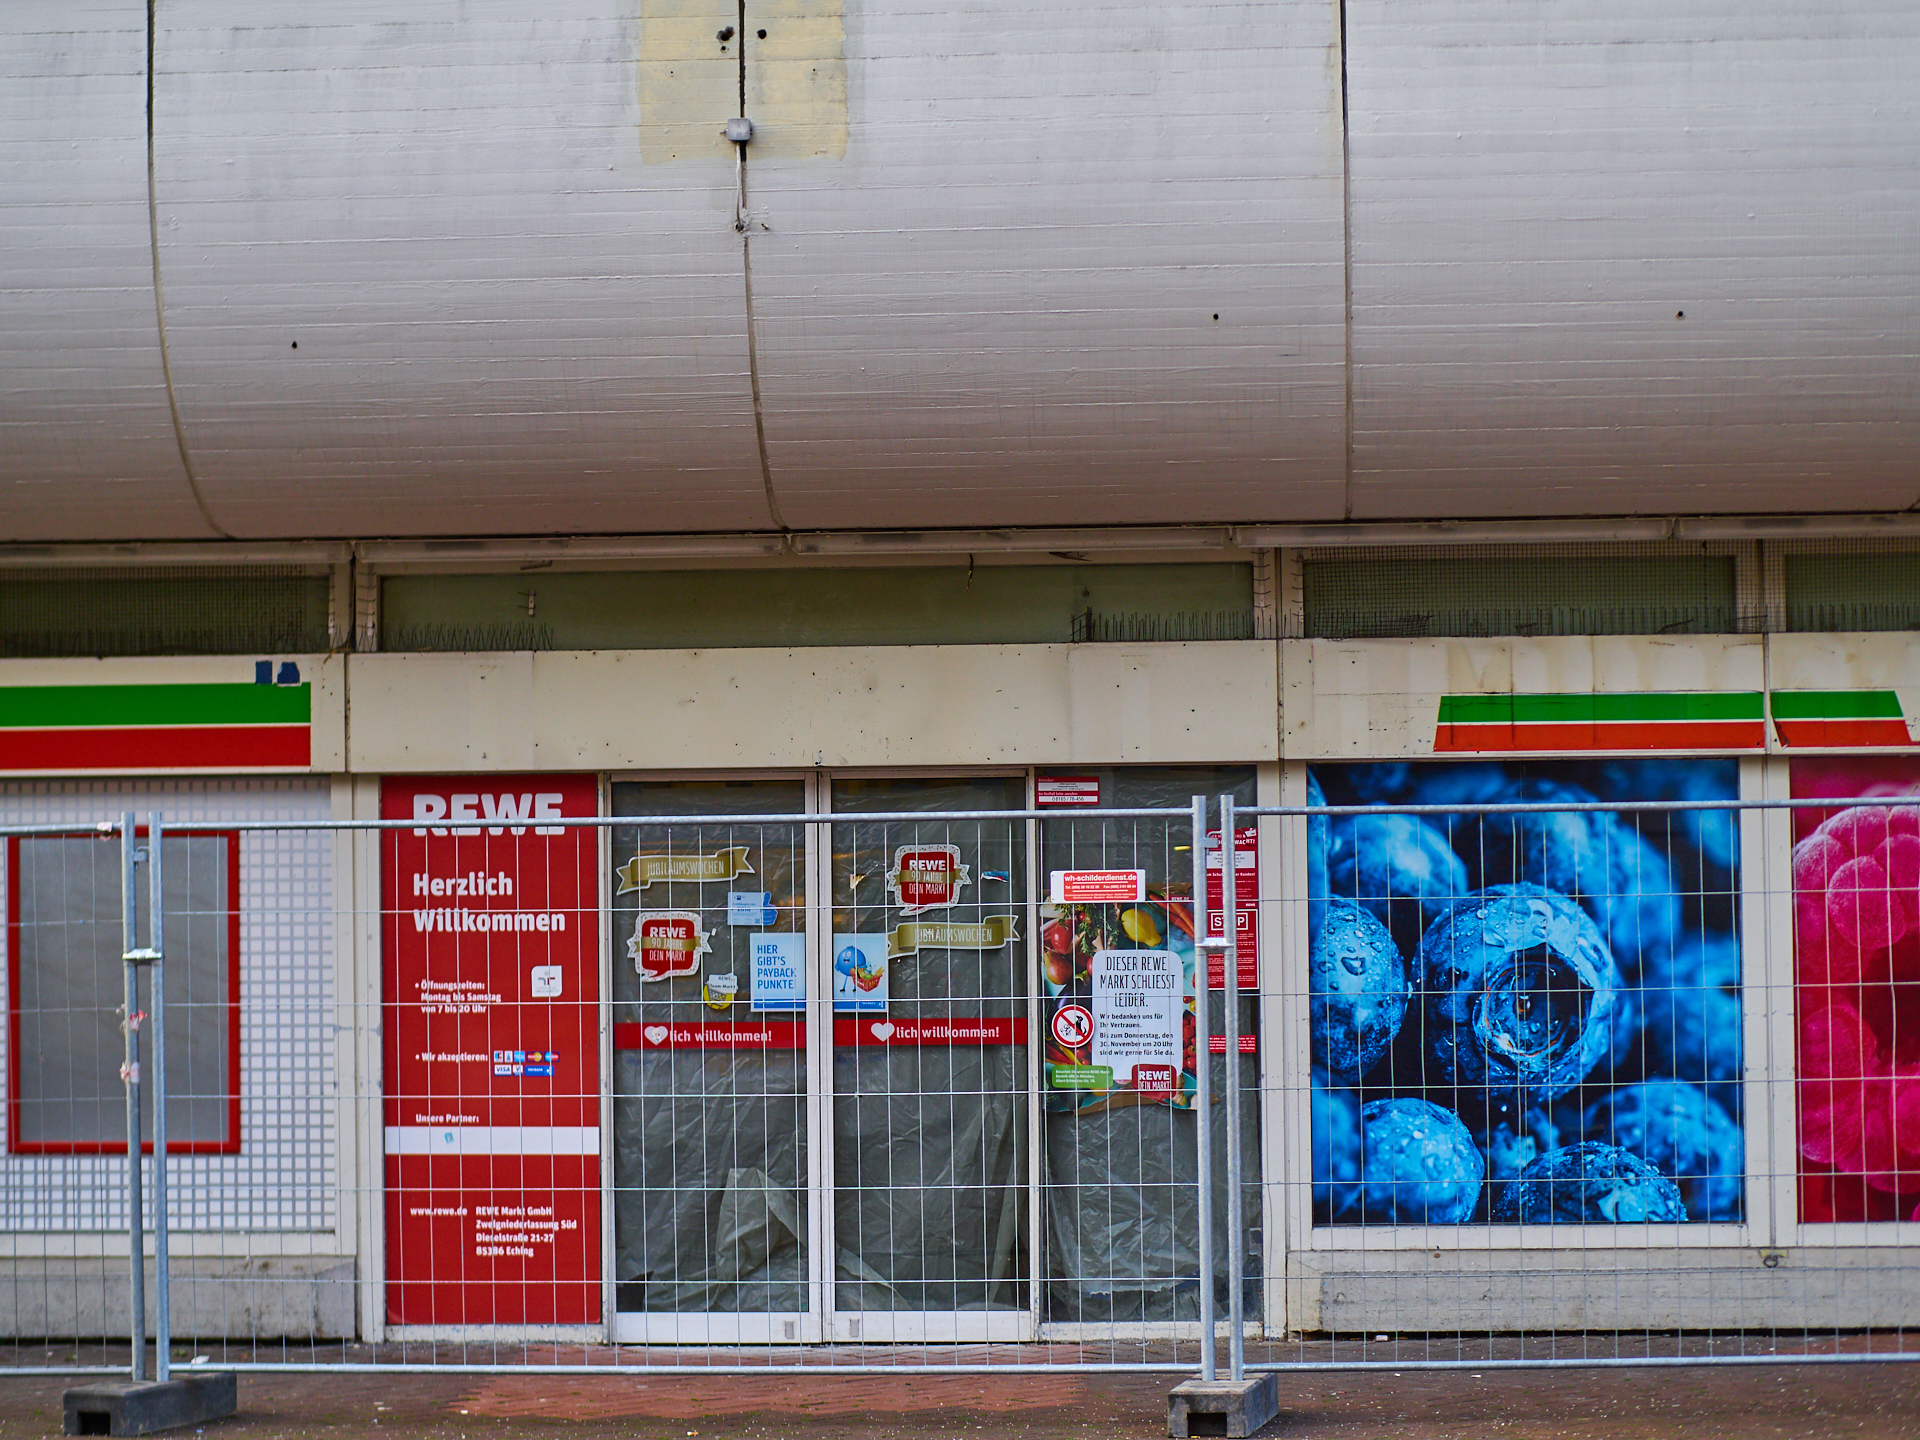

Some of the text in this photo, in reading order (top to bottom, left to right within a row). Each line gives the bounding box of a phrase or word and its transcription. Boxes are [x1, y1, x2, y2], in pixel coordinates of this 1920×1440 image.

[413, 793, 565, 836] REWE
[647, 859, 724, 877] JUBILÄUMSWOCHEN
[909, 860, 946, 870] REWE
[911, 871, 943, 882] 90 JAHRE
[413, 871, 512, 896] Herzlich
[925, 884, 945, 894] MARKT
[413, 907, 565, 932] Willkommen
[1214, 917, 1245, 926] SP
[650, 927, 686, 938] REWE
[914, 926, 992, 943] JUBILÄUMSWOCHEN
[651, 938, 683, 949] 90 JAHRE
[757, 945, 777, 954] HIER
[649, 950, 685, 961] DEIN MARKT
[757, 956, 786, 966] GIBT'S
[1106, 956, 1167, 971] DIESER REWE
[757, 968, 797, 977] PAYBACK
[421, 979, 485, 991] Öffnungszeiten:
[1100, 974, 1175, 989] MARKT SCHLIESST
[421, 992, 501, 1002] Montag bis Samstag
[1114, 993, 1148, 1007] LEIDER.
[421, 1004, 486, 1013] von 7 bis 20 Uhr
[695, 1030, 772, 1041] willkommen!
[896, 1026, 999, 1038] lich willkommen!
[421, 1052, 488, 1063] Wir akzeptieren:
[1139, 1070, 1170, 1080] REWE
[1152, 1081, 1170, 1089] MARKT
[415, 1114, 479, 1123] Unsere Partner:
[410, 1205, 468, 1215] www.rewe.de
[475, 1206, 552, 1216] REWE Markt GmbH
[475, 1219, 577, 1231] Zweigniederlassung Süd
[475, 1232, 529, 1242] Dieselstraße
[475, 1245, 534, 1258] 85386 Eching
